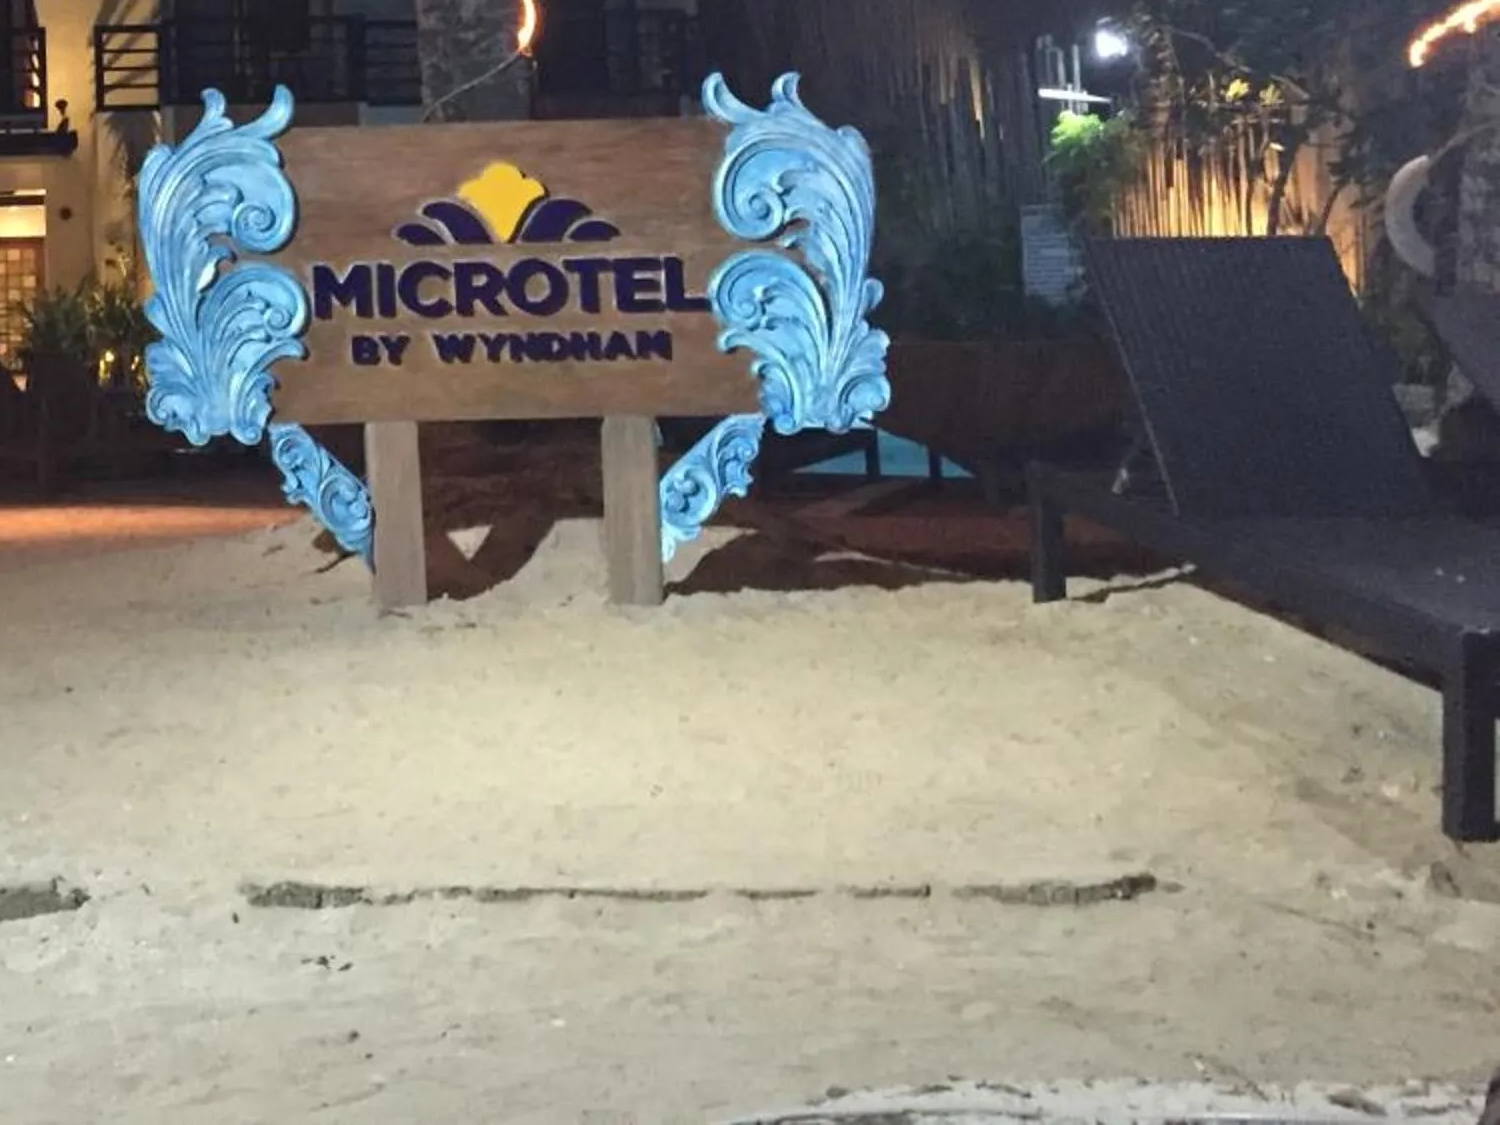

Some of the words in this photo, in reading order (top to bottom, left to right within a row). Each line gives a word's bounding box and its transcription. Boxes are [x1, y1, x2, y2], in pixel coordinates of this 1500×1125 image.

[312, 256, 713, 320] MICROTEL
[351, 334, 411, 366] BY
[432, 330, 673, 365] WYNDHAM
